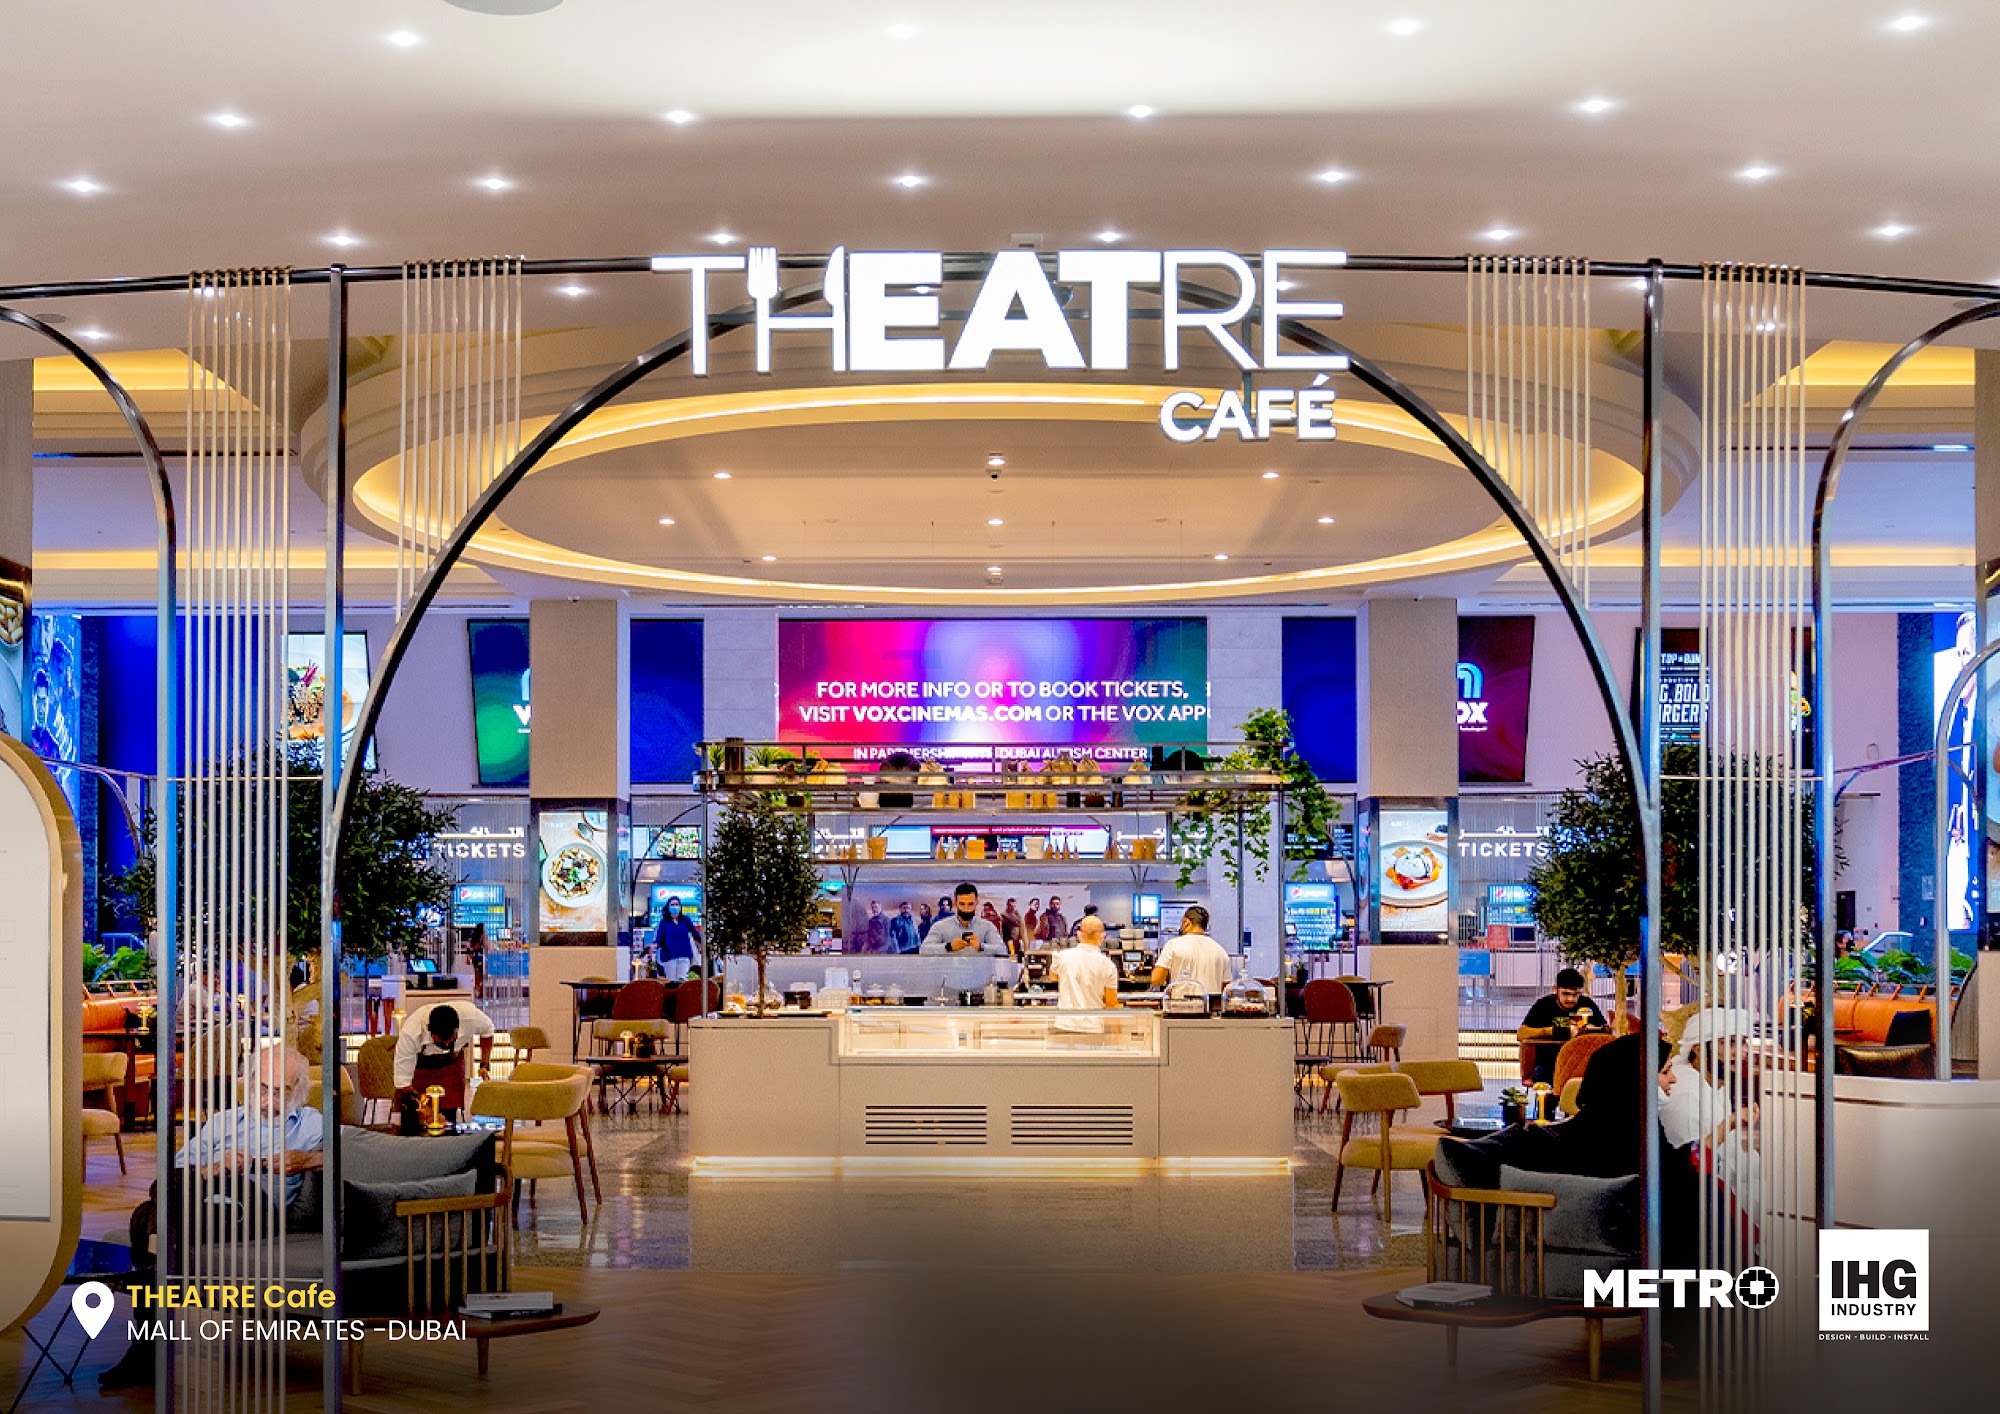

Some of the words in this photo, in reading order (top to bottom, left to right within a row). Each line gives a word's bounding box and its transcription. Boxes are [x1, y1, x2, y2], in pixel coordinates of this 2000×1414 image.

[651, 246, 1348, 376] THEATRE
[1159, 372, 1337, 442] CAFÉ
[816, 681, 858, 699] FOR
[861, 681, 919, 699] MORE
[923, 681, 971, 699] INFO
[974, 681, 1004, 699] OR
[1006, 681, 1036, 699] TO
[1039, 681, 1099, 699] BOOK
[1100, 681, 1189, 699] TICKETS,
[799, 705, 850, 722] VISIT
[852, 705, 1042, 722] VOXCINEMAS.COM
[1045, 705, 1074, 722] OR
[1077, 705, 1119, 722] THE
[1121, 705, 1165, 722] VOX
[1167, 705, 1206, 722] APP
[854, 747, 868, 759] IN
[999, 747, 1039, 759] DUBAI
[1094, 747, 1148, 759] CENTER
[434, 842, 525, 859] TICKETS
[1457, 842, 1549, 858] TICKETS
